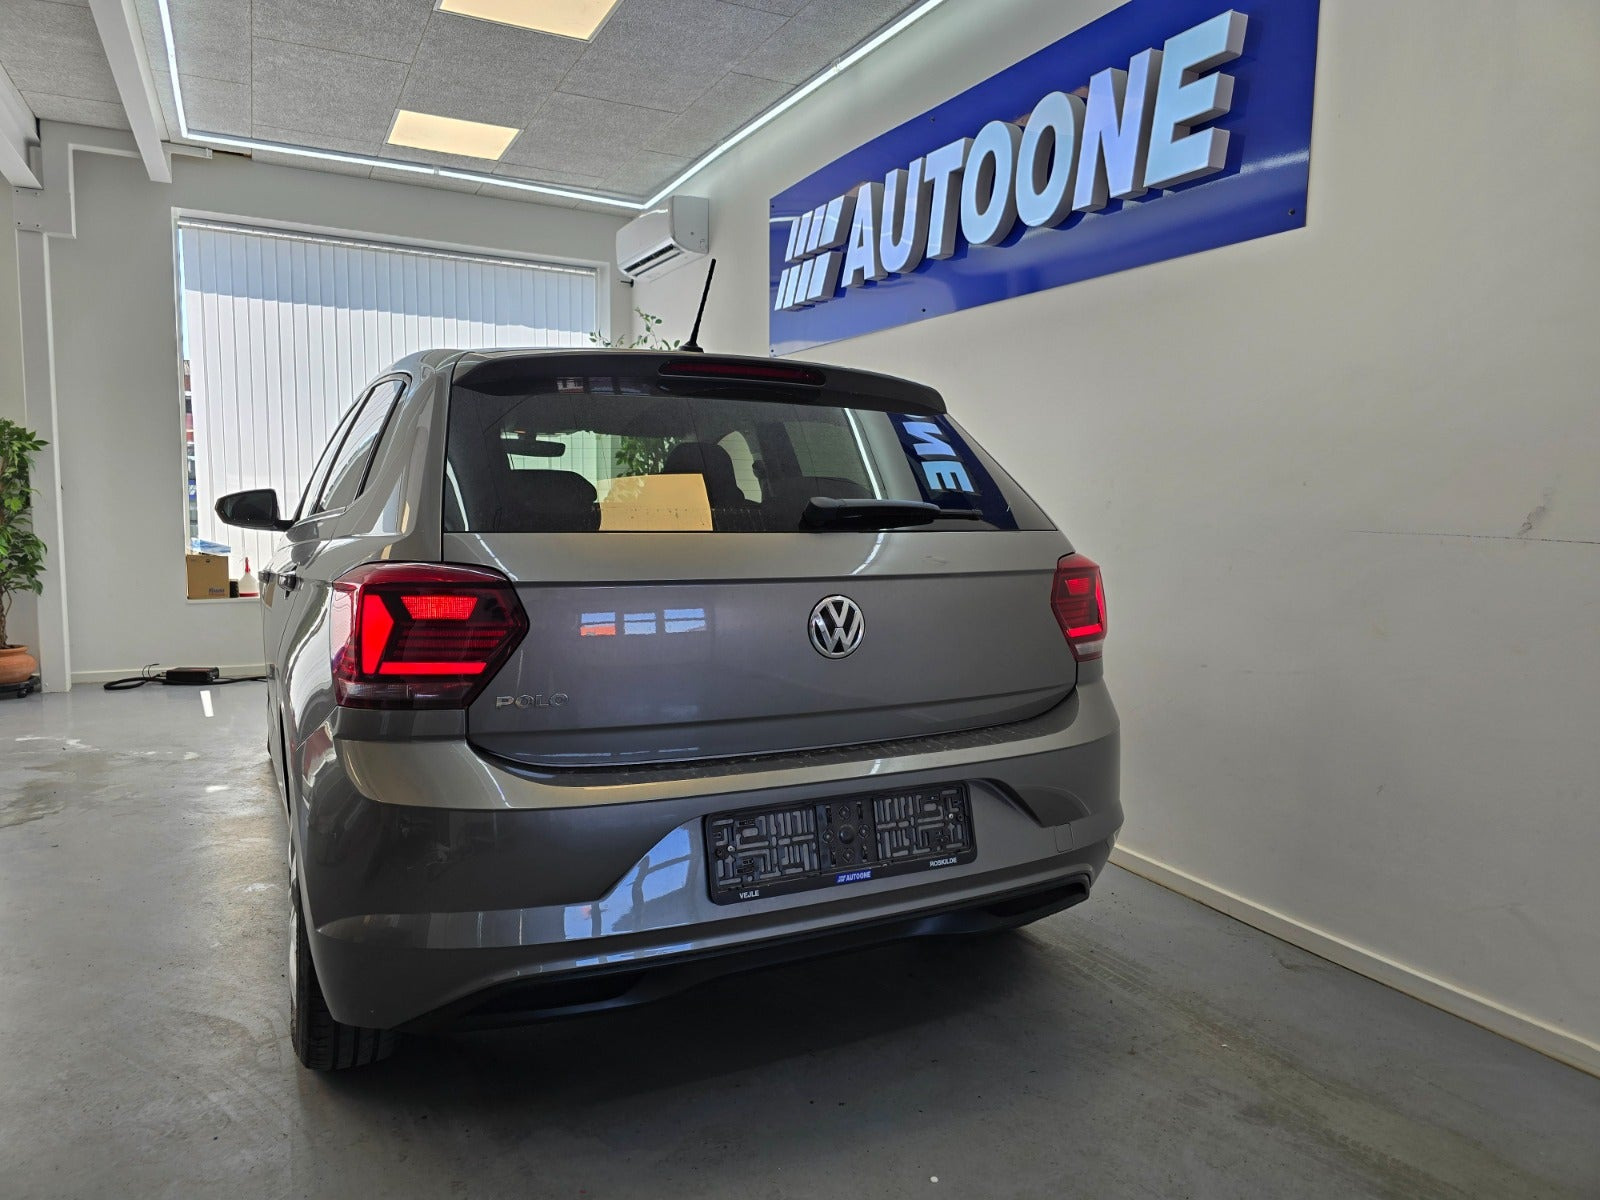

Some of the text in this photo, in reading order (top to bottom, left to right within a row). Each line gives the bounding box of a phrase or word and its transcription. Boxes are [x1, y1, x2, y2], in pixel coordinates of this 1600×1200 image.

[841, 9, 1248, 288] AUTOONE
[808, 594, 866, 660] VW
[496, 693, 568, 708] POLO
[845, 871, 871, 881] AUTOONE
[739, 889, 760, 899] VEJLE
